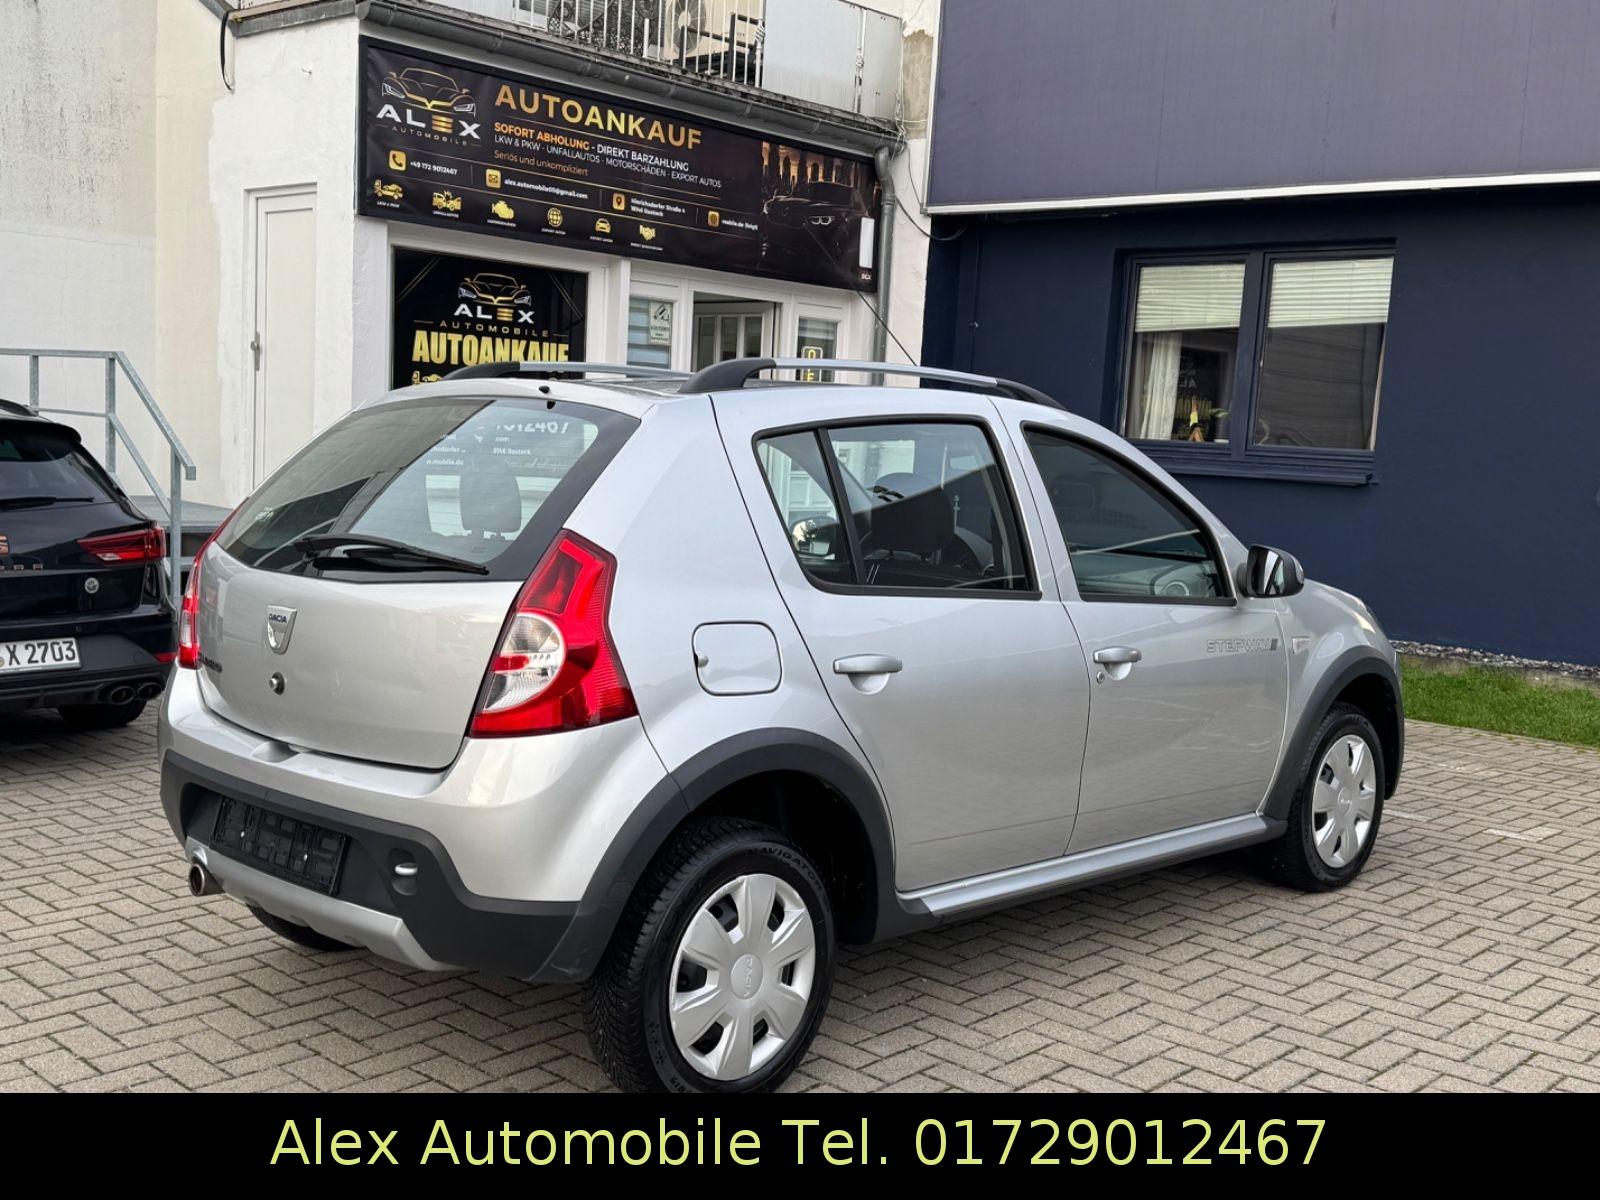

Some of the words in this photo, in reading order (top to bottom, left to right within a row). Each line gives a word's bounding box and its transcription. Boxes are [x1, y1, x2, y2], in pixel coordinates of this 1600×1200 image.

[376, 103, 480, 140] ALEX
[494, 84, 702, 149] AUTOANKAUF
[391, 126, 467, 146] AUTOMOBILE
[494, 122, 535, 139] SOFORT
[537, 131, 590, 151] ABHOLUNG
[597, 144, 630, 159] DIREKT
[631, 150, 689, 171] BARZAHLUNG
[494, 134, 514, 146] LKW
[514, 139, 520, 147] &
[521, 139, 541, 151] PKW
[546, 145, 600, 163] UNFALLAUTOS
[671, 171, 699, 183] EXPORT
[699, 176, 721, 188] AUTOS
[519, 156, 535, 166] und
[536, 159, 589, 177] unkompliziert
[454, 303, 535, 324] ALEX
[439, 320, 549, 337] AUTOMOBILE
[412, 330, 569, 366] AUTOANKAUF
[6, 645, 20, 665] X
[25, 641, 76, 664] 2703
[1207, 639, 1270, 653] STEPWAY
